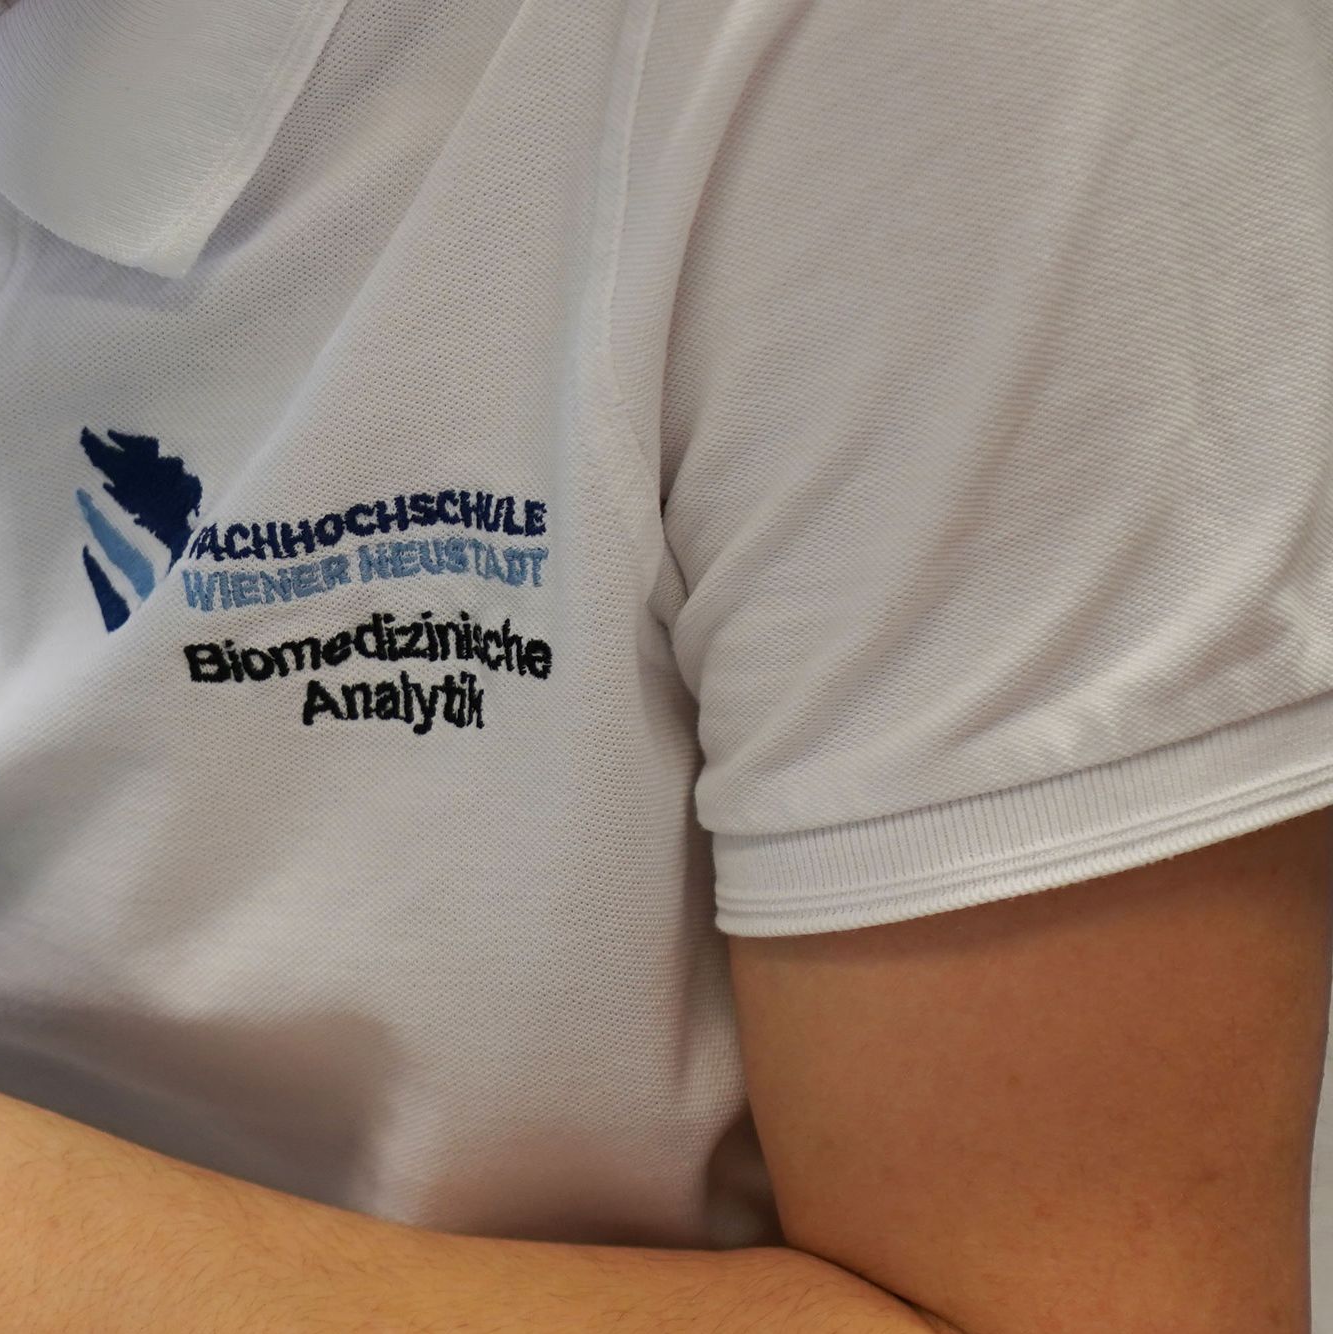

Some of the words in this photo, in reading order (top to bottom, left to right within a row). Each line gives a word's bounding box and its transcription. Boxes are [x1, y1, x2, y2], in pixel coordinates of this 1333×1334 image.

[189, 490, 547, 561] ACHHOCHSCHULE
[183, 553, 351, 612] WIENER
[358, 537, 549, 587] NEUSTADT
[183, 611, 552, 681] Biomedizinische
[302, 670, 485, 735] Analytik
